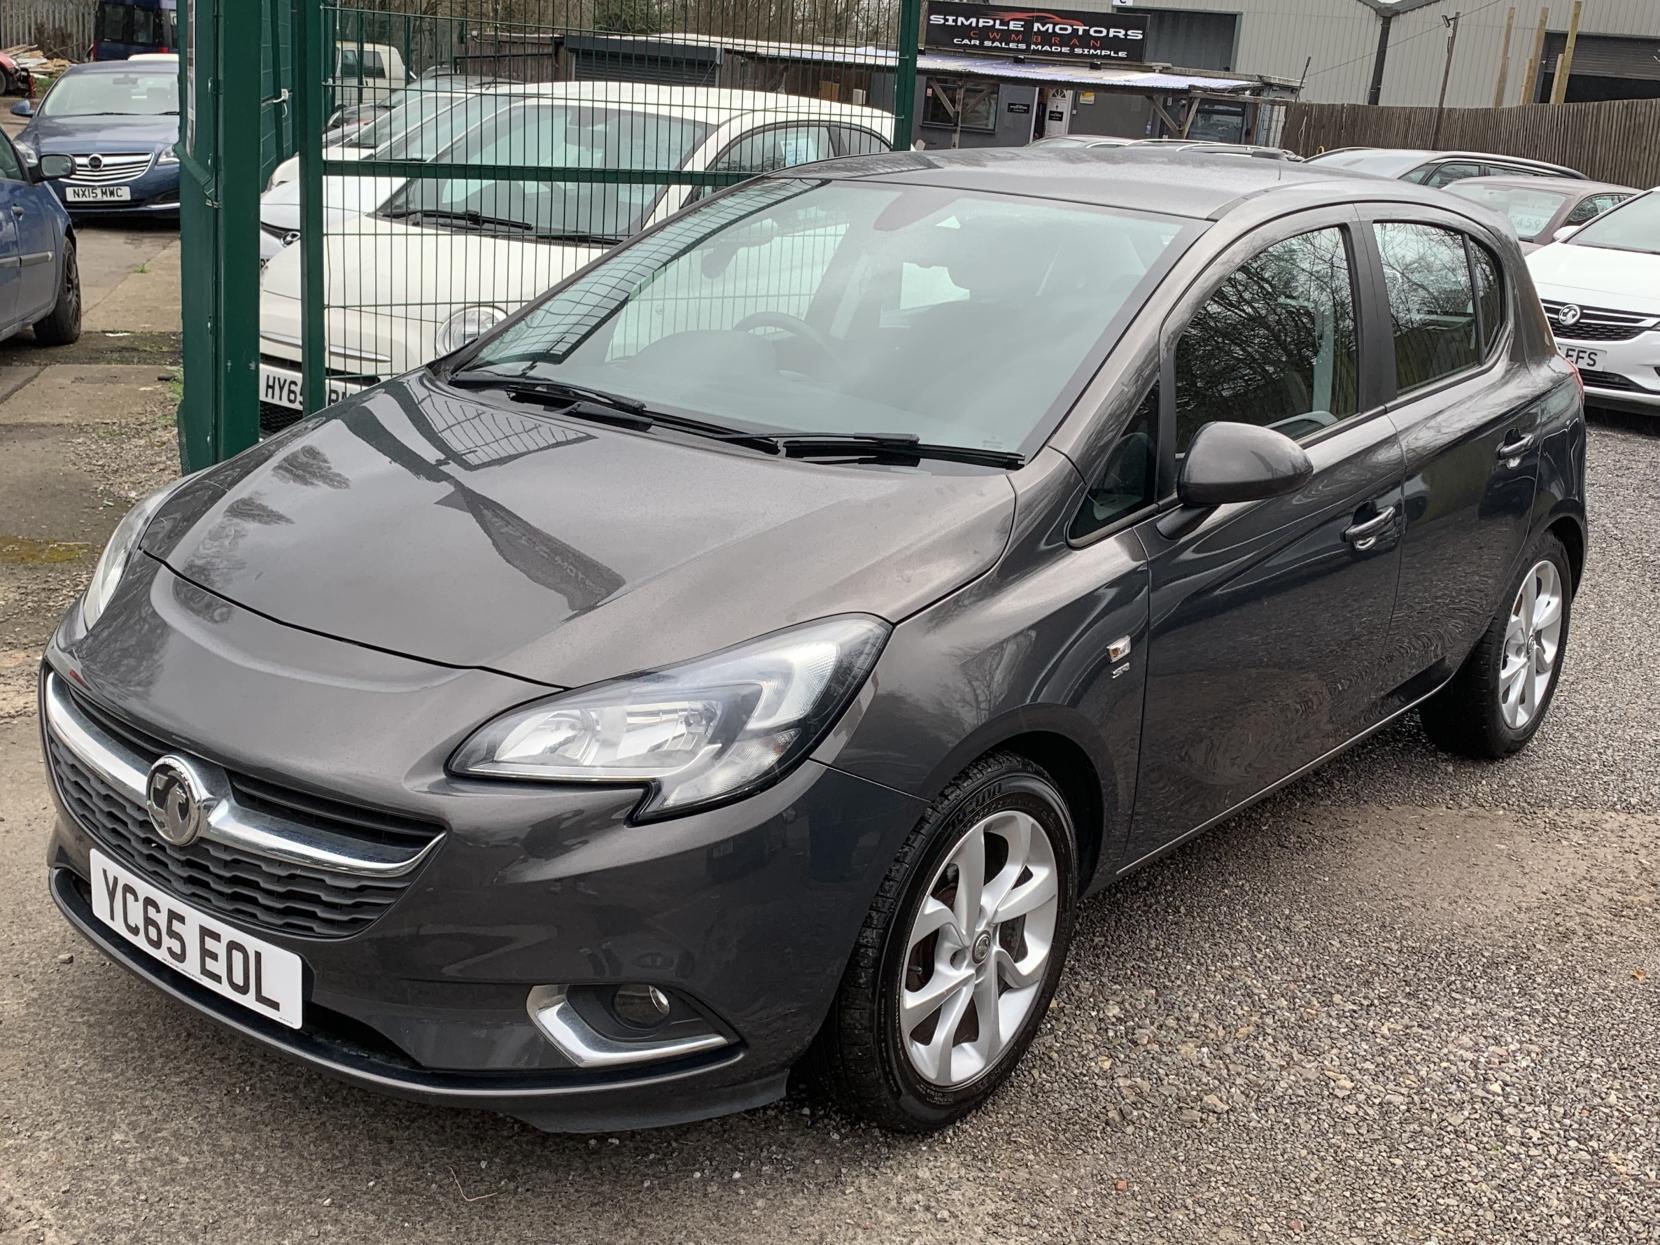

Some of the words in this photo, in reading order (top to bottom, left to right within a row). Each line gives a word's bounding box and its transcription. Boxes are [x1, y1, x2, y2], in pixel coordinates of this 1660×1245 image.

[929, 14, 1025, 31] SIMPLE
[1033, 22, 1143, 40] MOTORS
[953, 38, 980, 46] CAR
[983, 40, 1026, 50] SALES
[1030, 44, 1070, 53] MADE
[1074, 47, 1128, 58] SIMPLE
[73, 188, 98, 199] NX15
[101, 187, 123, 199] MWC
[265, 374, 303, 406] HY6
[102, 867, 187, 964] YC65
[198, 923, 281, 1012] EOL
